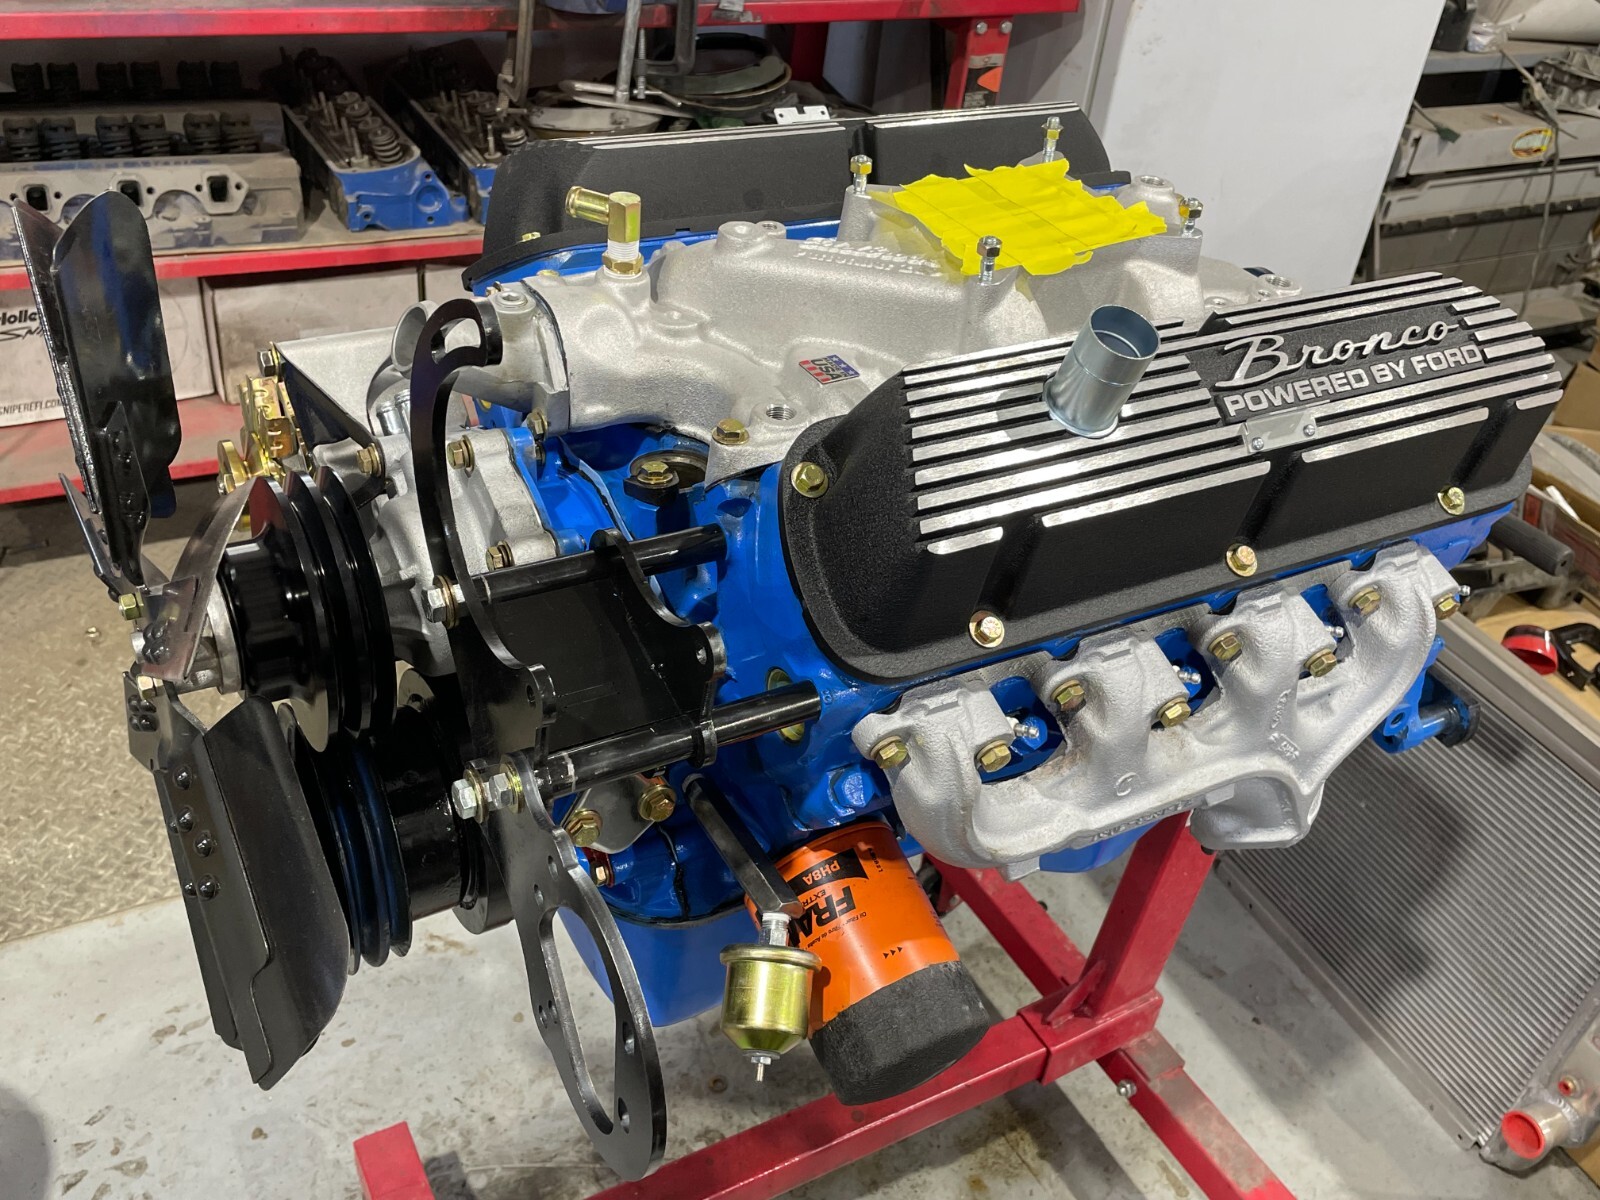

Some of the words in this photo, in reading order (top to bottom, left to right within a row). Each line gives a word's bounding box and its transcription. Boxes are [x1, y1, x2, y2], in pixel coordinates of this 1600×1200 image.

[1215, 320, 1460, 388] Bronco
[810, 358, 843, 380] USA
[1223, 368, 1370, 417] POWERED
[1370, 359, 1405, 385] BY
[1410, 344, 1483, 375] FORD
[802, 860, 840, 886] PH8A
[802, 889, 826, 907] EXTR
